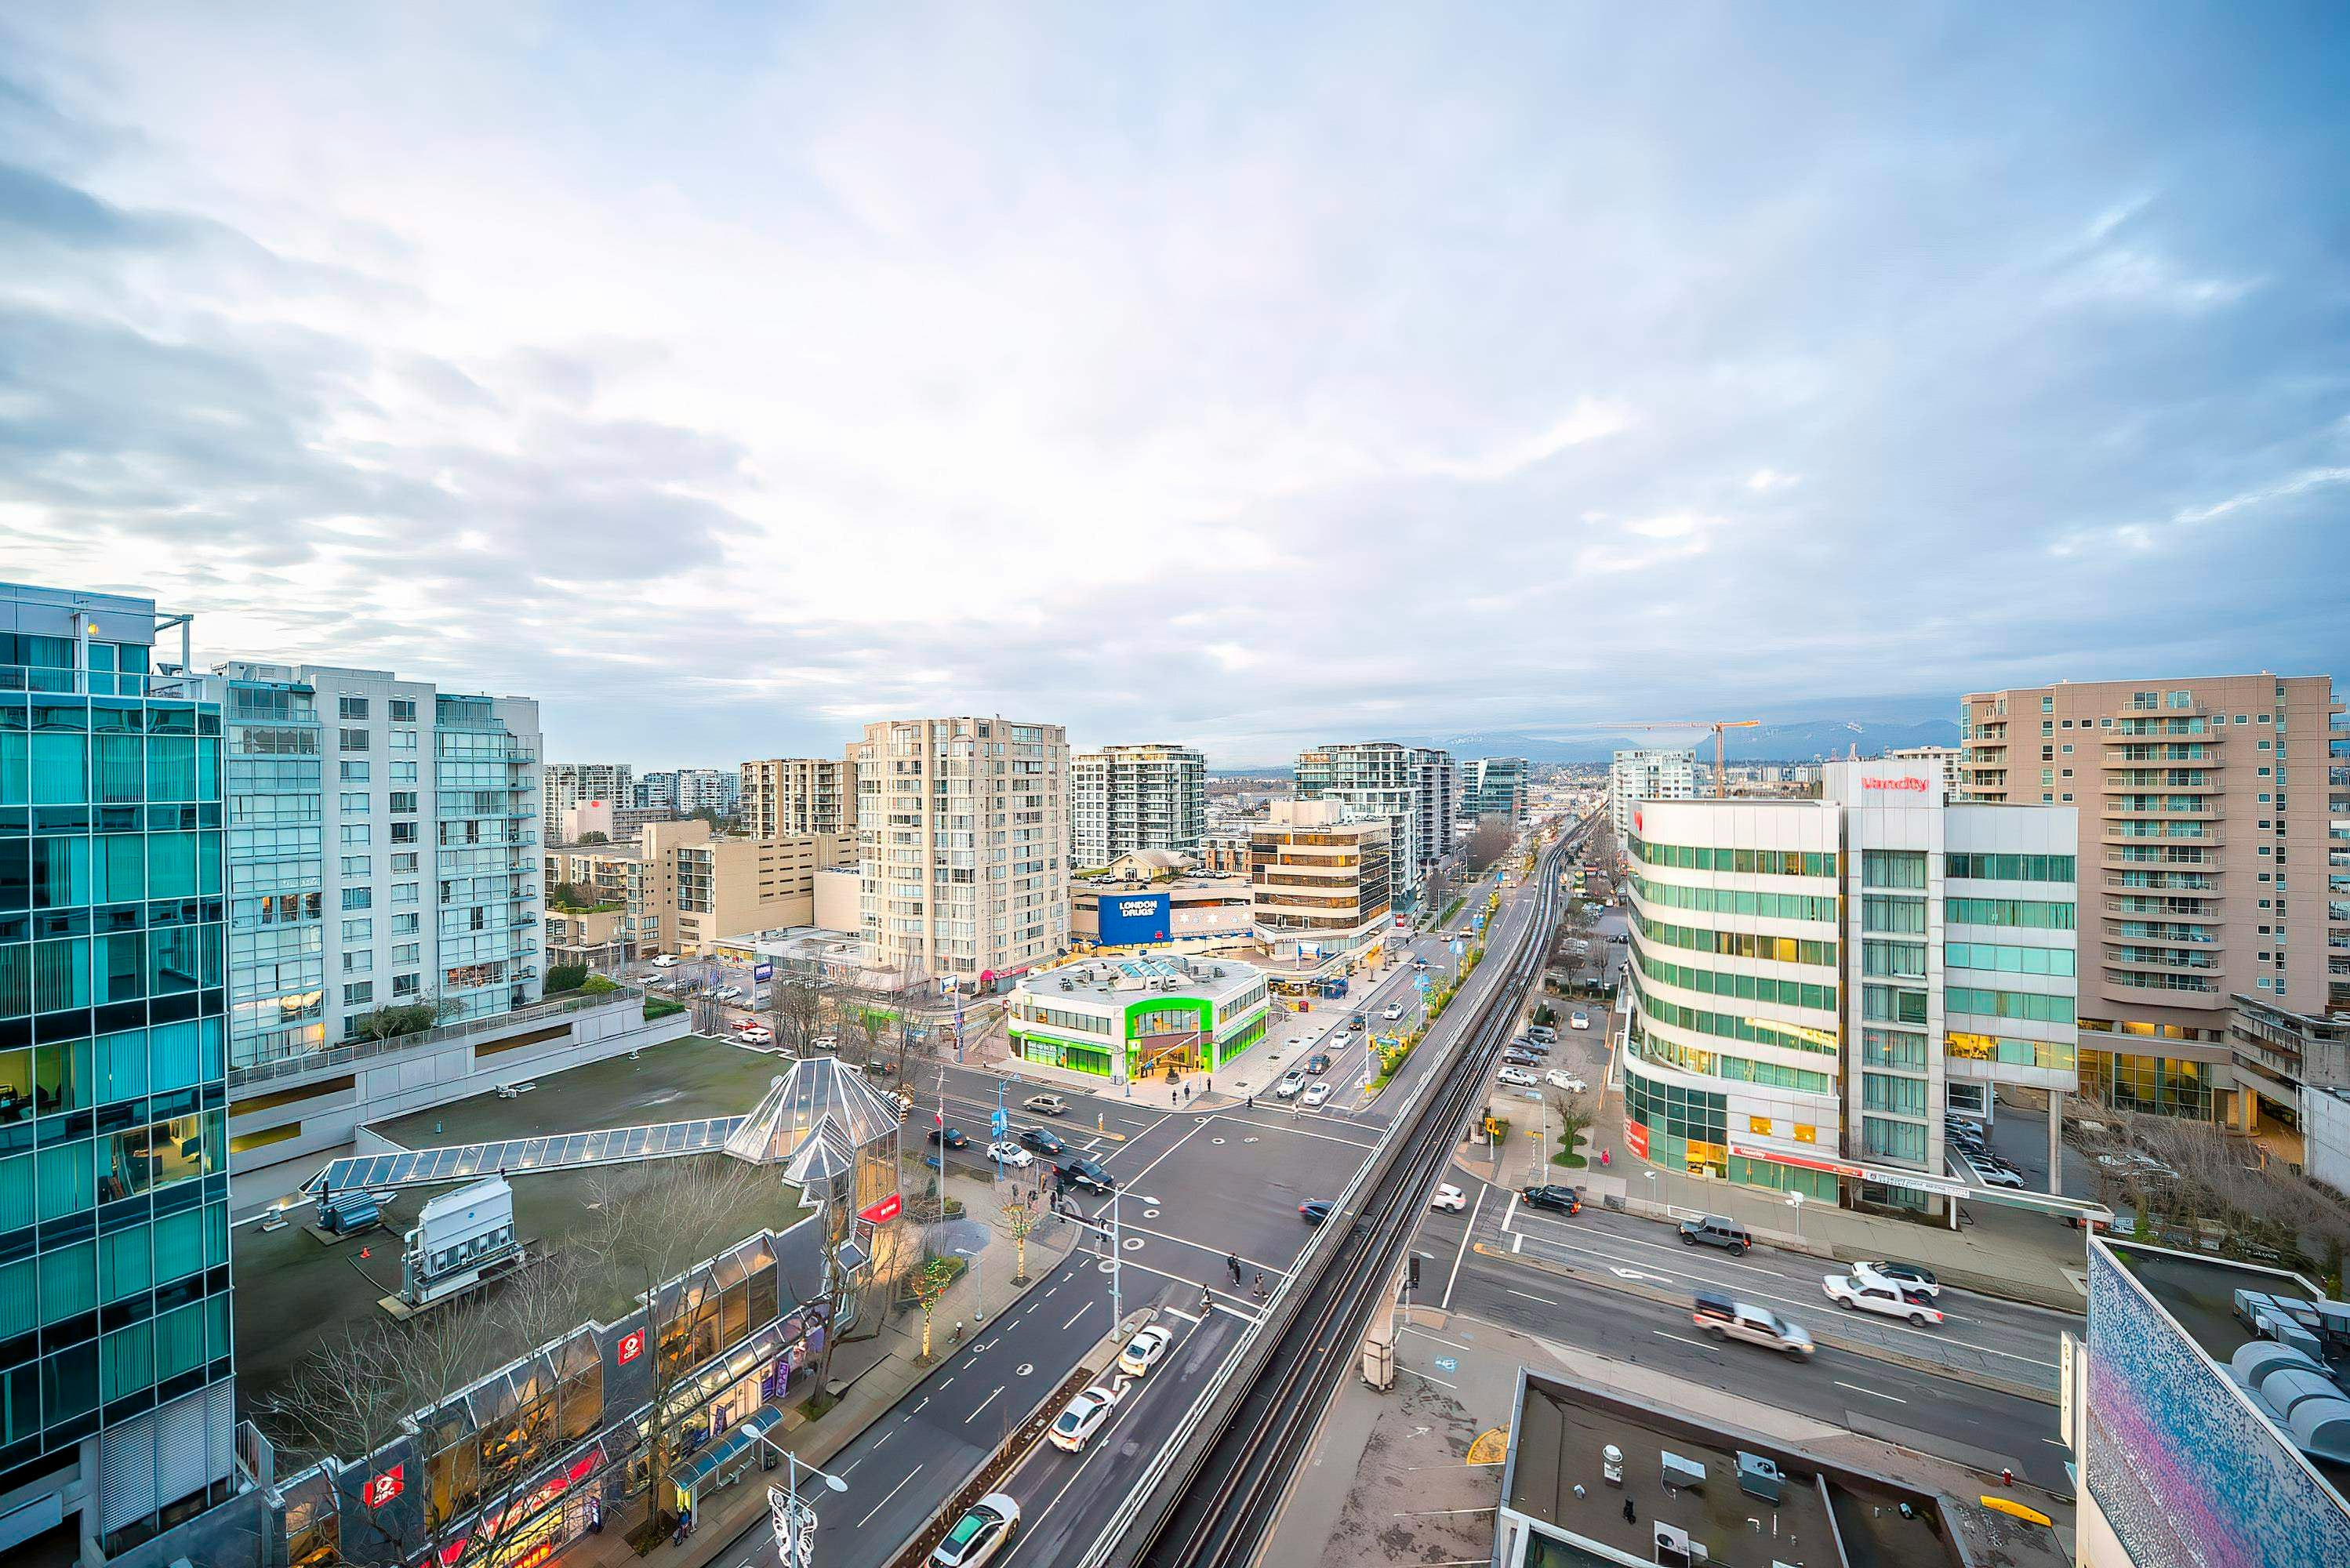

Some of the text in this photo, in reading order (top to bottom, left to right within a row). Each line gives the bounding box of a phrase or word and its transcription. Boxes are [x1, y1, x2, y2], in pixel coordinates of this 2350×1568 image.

[1119, 900, 1158, 910] LONDON
[1122, 908, 1155, 917] DRUGS
[373, 1486, 395, 1504] CIBC
